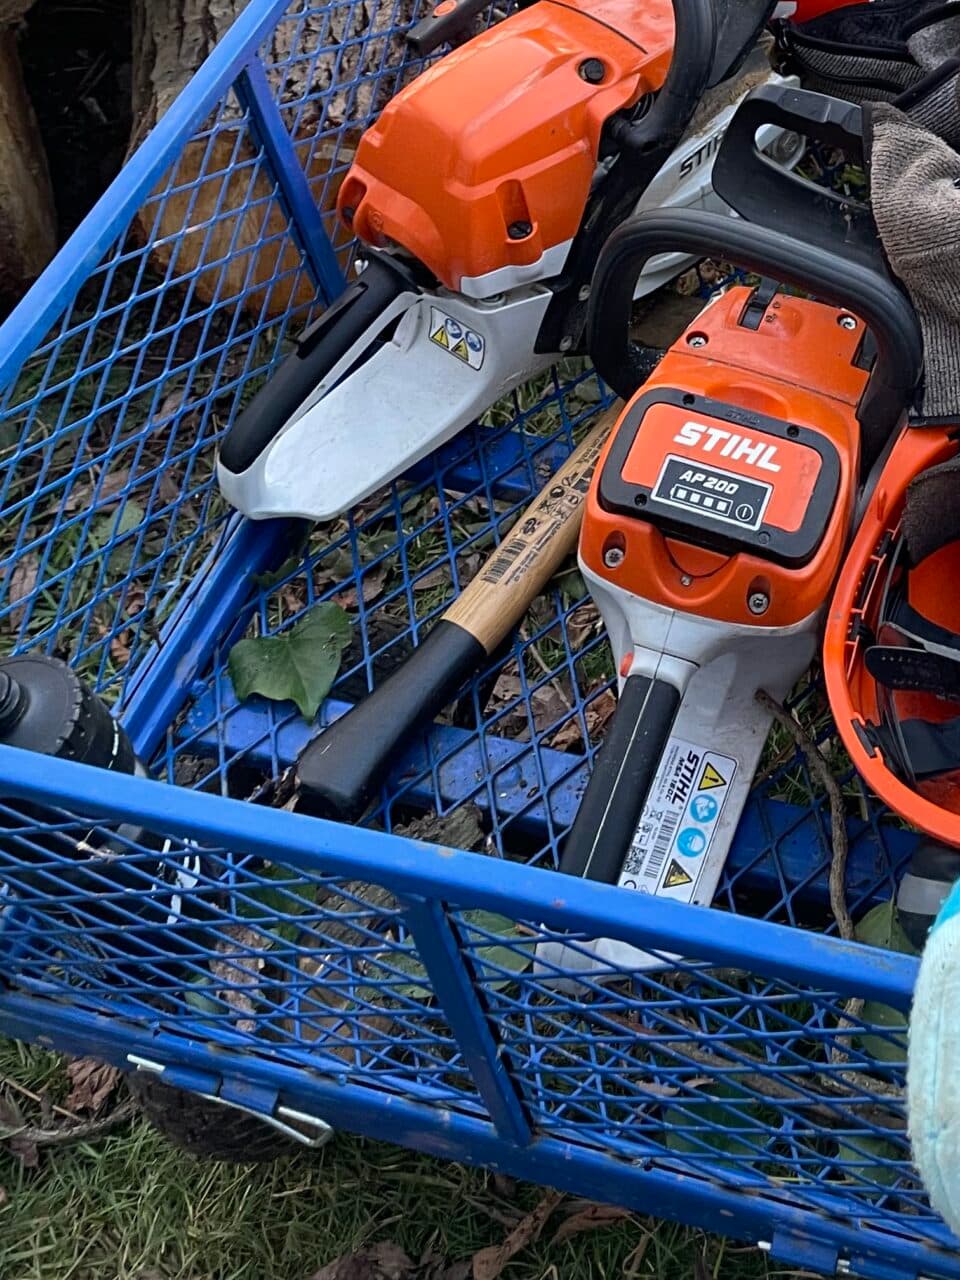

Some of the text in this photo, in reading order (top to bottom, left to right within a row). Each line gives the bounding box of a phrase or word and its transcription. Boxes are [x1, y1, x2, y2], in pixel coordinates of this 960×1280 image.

[679, 136, 719, 180] STI
[673, 421, 782, 473] STIHL
[671, 750, 700, 805] STIHL
[673, 756, 685, 778] MSA
